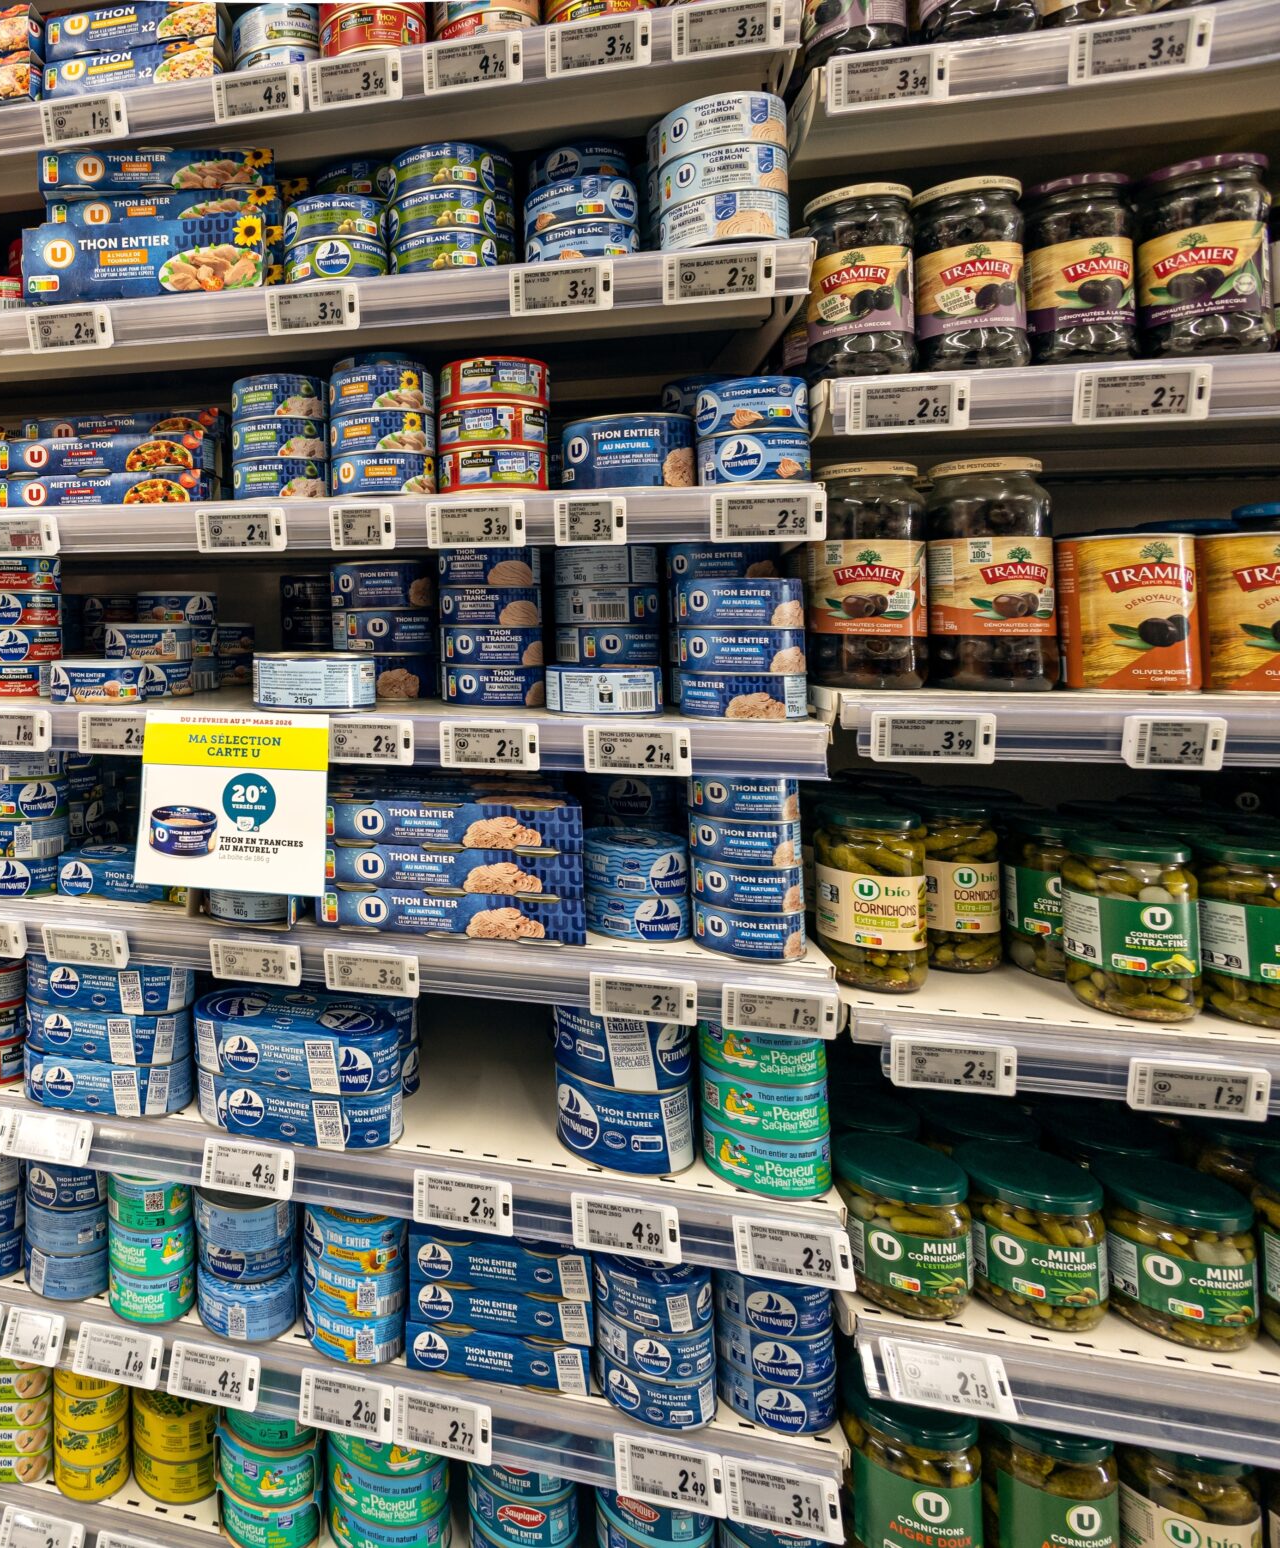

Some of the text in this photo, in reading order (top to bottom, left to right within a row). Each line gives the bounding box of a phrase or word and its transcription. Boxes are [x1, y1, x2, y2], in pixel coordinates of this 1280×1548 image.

[94, 6, 134, 20] THON
[141, 21, 155, 33] x2
[138, 68, 152, 78] x2
[694, 99, 742, 112] THON BLANC
[701, 105, 735, 116] GERMON
[701, 147, 750, 159] THON BLANC
[709, 154, 743, 164] GERMON
[78, 235, 169, 251] THON ENTIER
[1157, 248, 1234, 273] TRAMIER
[943, 262, 1010, 281] TRAMIER
[822, 268, 887, 289] TRAMIER
[731, 389, 752, 397] THON
[753, 387, 776, 395] BLANC
[836, 568, 902, 582] TRAMIER
[198, 716, 228, 724] FÉVRIER
[189, 733, 281, 746] MA SÉLECTION
[207, 748, 260, 758] CARTE U
[388, 809, 454, 818] THON ENTIER
[220, 836, 304, 848] THON EN TRANCHES
[219, 844, 230, 852] AU
[232, 845, 270, 854] NATUREL
[389, 853, 455, 863] THON ENTIER
[392, 897, 457, 908] THON ENTIER
[854, 902, 916, 916] CORNICHONS
[856, 916, 896, 927] Extra-fins
[1125, 936, 1188, 947] EXTRA-FINS
[750, 1145, 767, 1153] Thon
[769, 1149, 788, 1157] entier
[923, 1242, 956, 1254] MINI
[908, 1252, 966, 1263] CORNICHONS
[1048, 1249, 1085, 1263] MINI
[1032, 1258, 1097, 1271] CORNICHONS
[483, 1266, 516, 1276] NATUREL
[1206, 1268, 1243, 1280] MINI
[1189, 1278, 1252, 1289] CORNICHONS
[484, 1308, 516, 1318] NATUREL
[479, 1357, 512, 1368] NATUREL
[504, 1507, 542, 1522] Saupiquet
[889, 1520, 933, 1547] AIGRE
